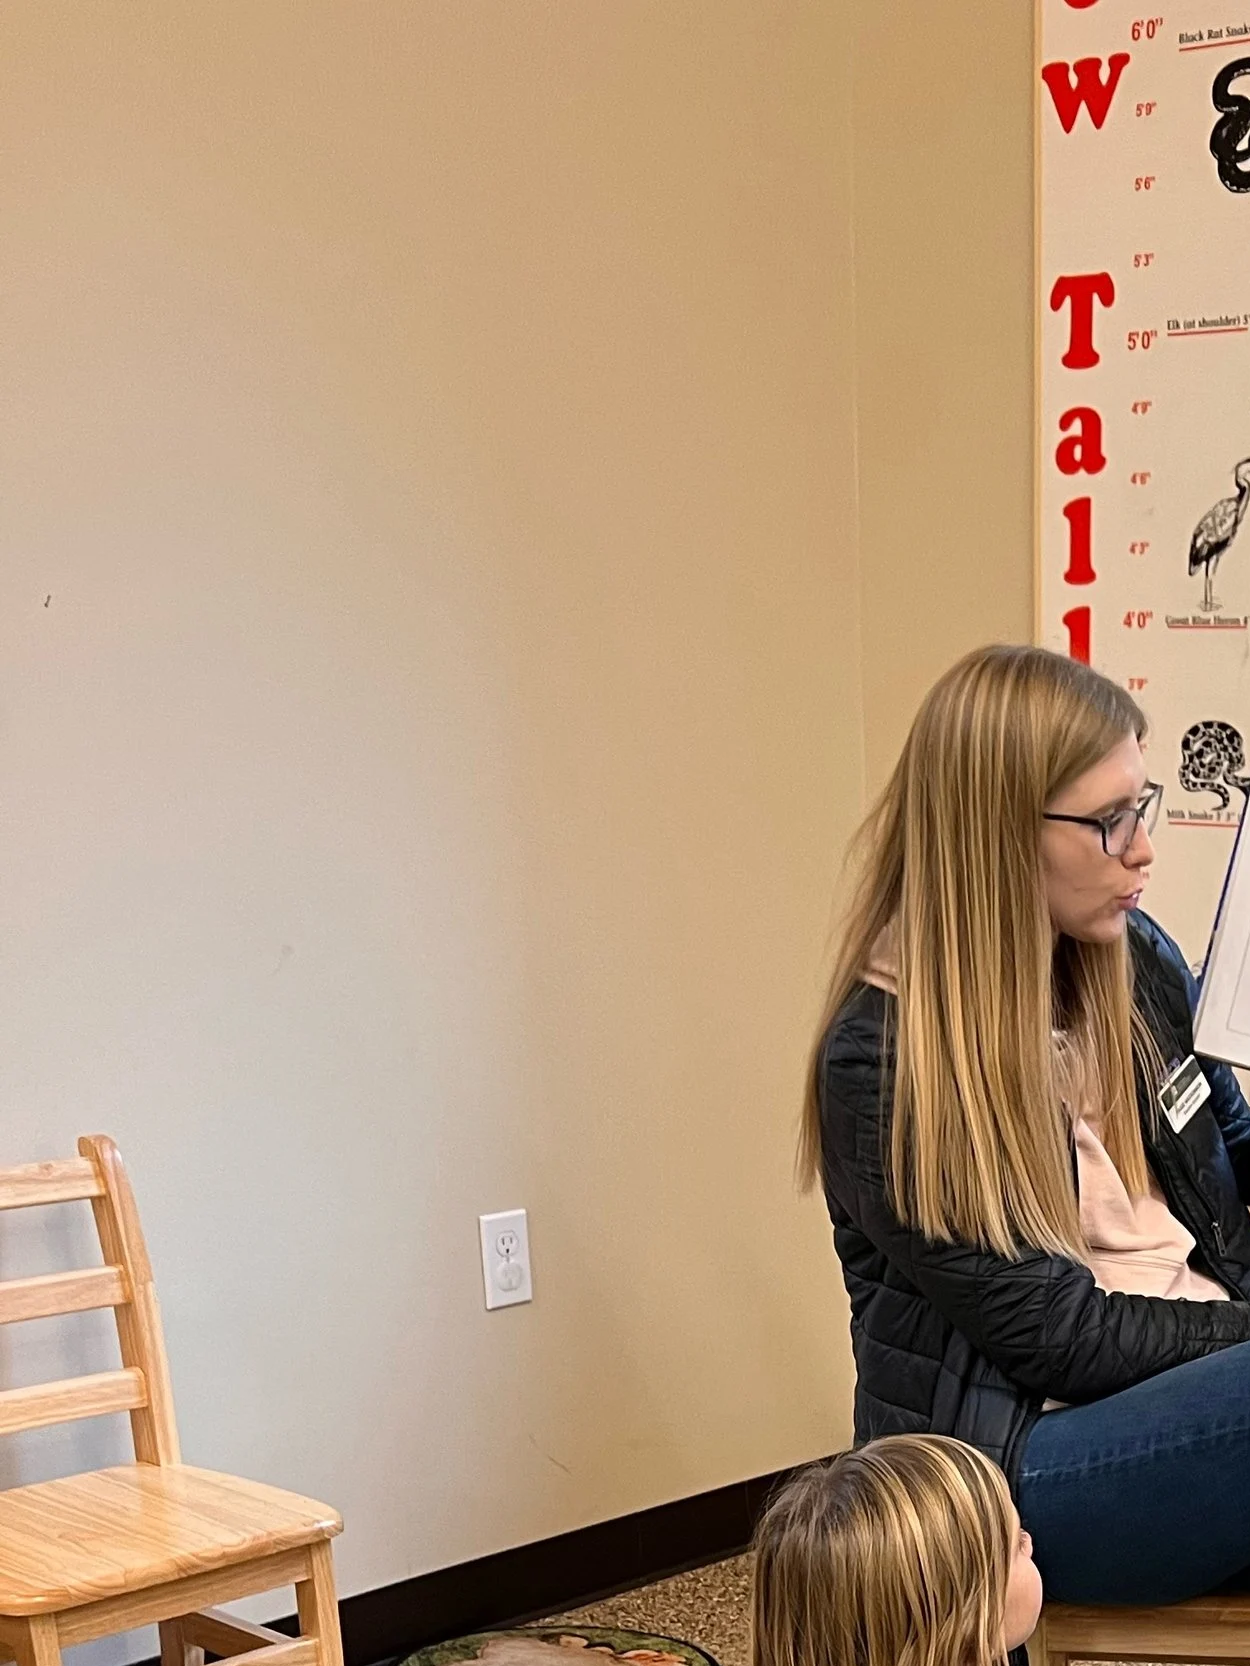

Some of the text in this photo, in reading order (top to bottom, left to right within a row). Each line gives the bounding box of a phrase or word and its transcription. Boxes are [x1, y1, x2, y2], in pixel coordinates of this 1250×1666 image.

[1178, 29, 1204, 44] Black
[1207, 28, 1224, 40] Rat
[1166, 319, 1181, 331] Elk
